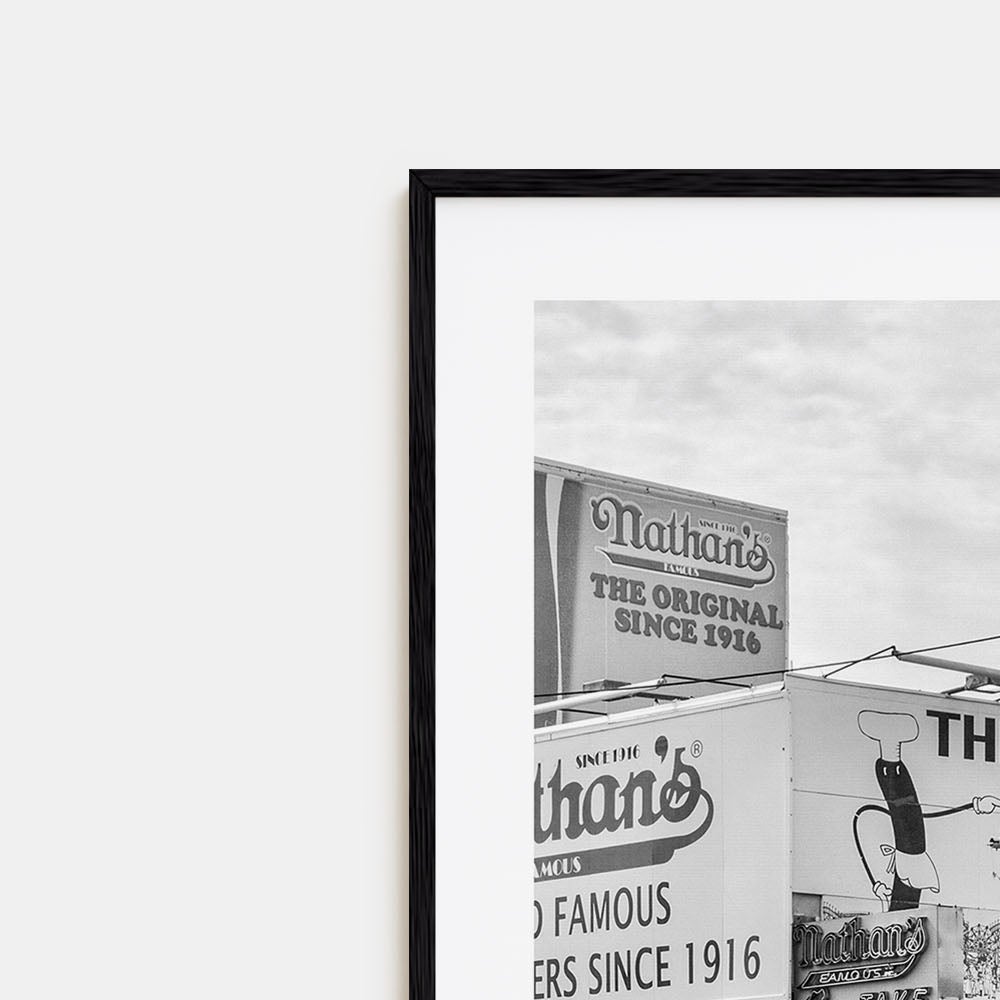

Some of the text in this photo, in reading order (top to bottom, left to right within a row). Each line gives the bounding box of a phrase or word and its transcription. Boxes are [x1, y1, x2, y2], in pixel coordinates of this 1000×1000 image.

[590, 497, 769, 572] Nathan's
[590, 573, 783, 630] THE ORIGINAL
[614, 608, 761, 655] SINCE 1916
[575, 744, 640, 769] SINCE 1916
[555, 882, 672, 936] FAMOUS
[589, 945, 672, 995] SINCE
[686, 935, 760, 985] 1916
[793, 916, 928, 968] Nathan's
